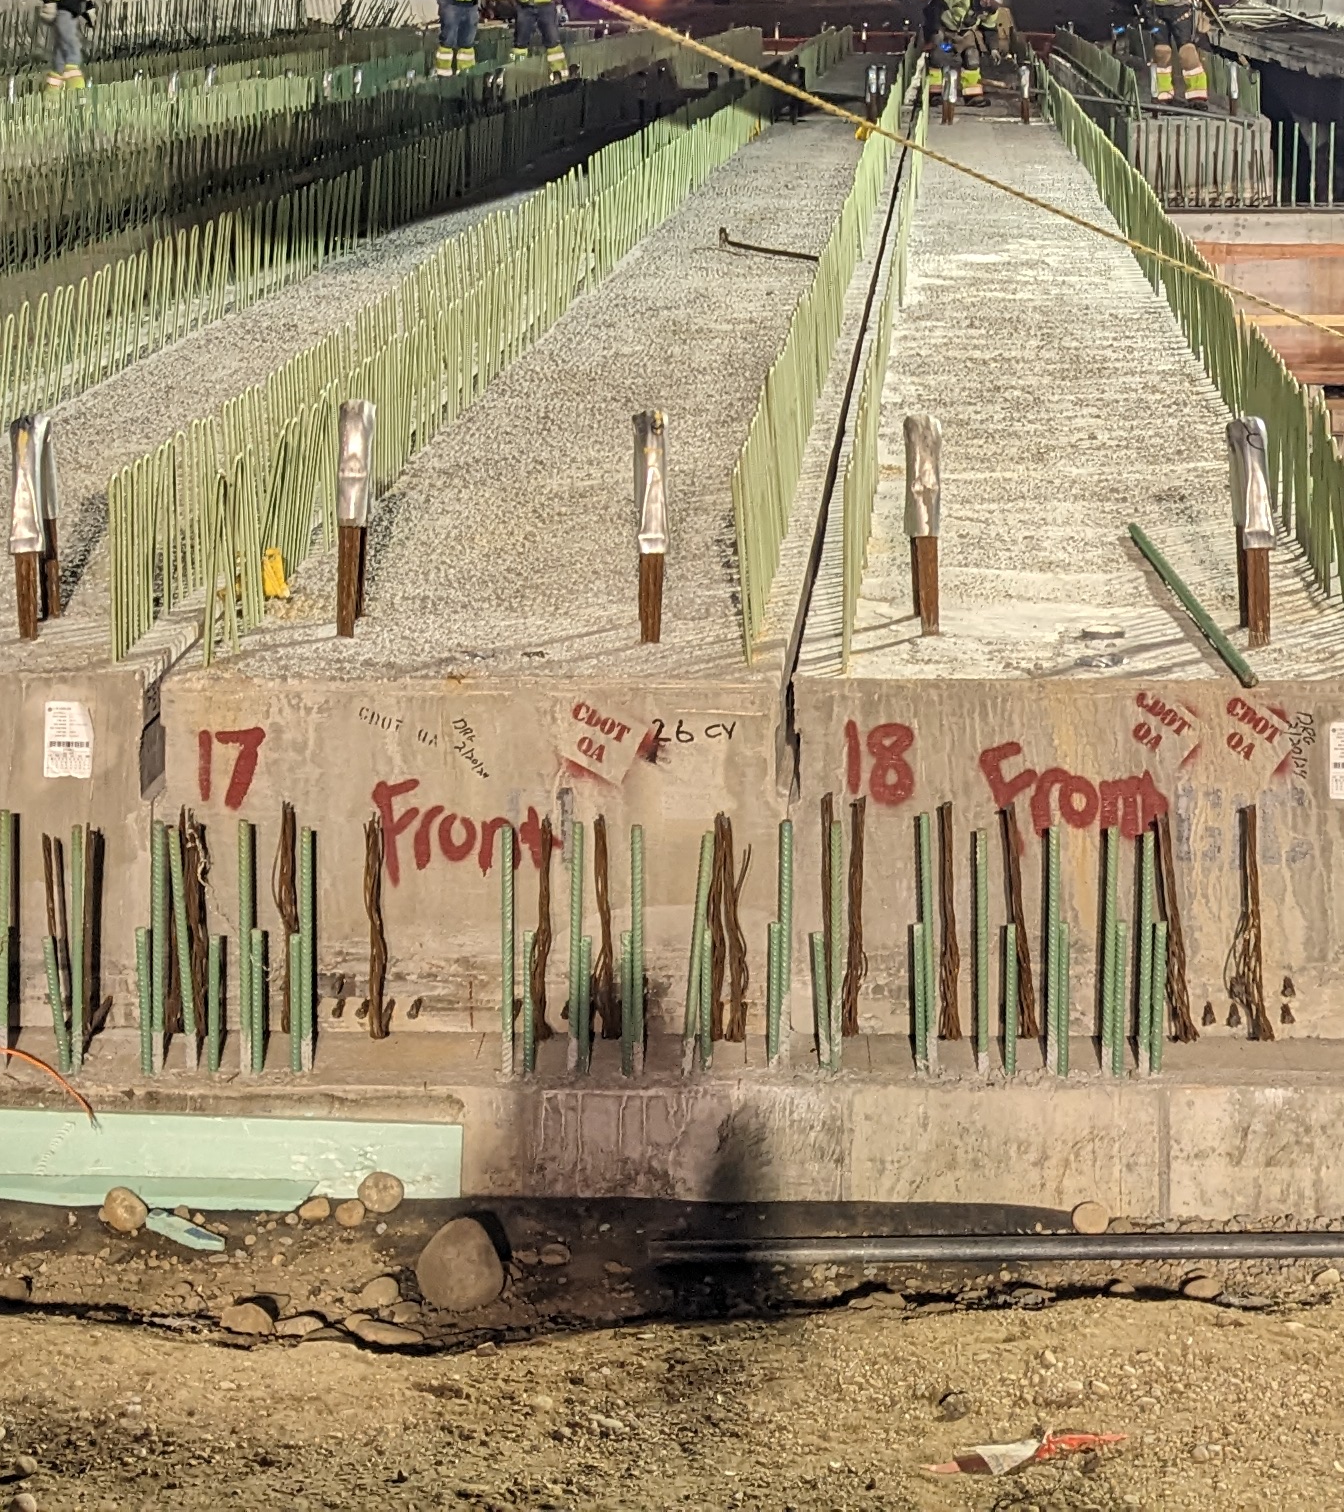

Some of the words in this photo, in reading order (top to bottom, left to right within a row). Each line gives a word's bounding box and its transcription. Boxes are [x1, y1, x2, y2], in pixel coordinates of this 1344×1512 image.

[571, 701, 631, 744] CDOT
[1132, 721, 1163, 752] QA
[1136, 692, 1192, 737] CDOT
[1226, 697, 1282, 744] CDOT
[197, 726, 266, 810] 17
[576, 735, 607, 764] QA
[844, 719, 915, 807] 18
[1226, 731, 1256, 761] QA
[370, 777, 564, 888] Front
